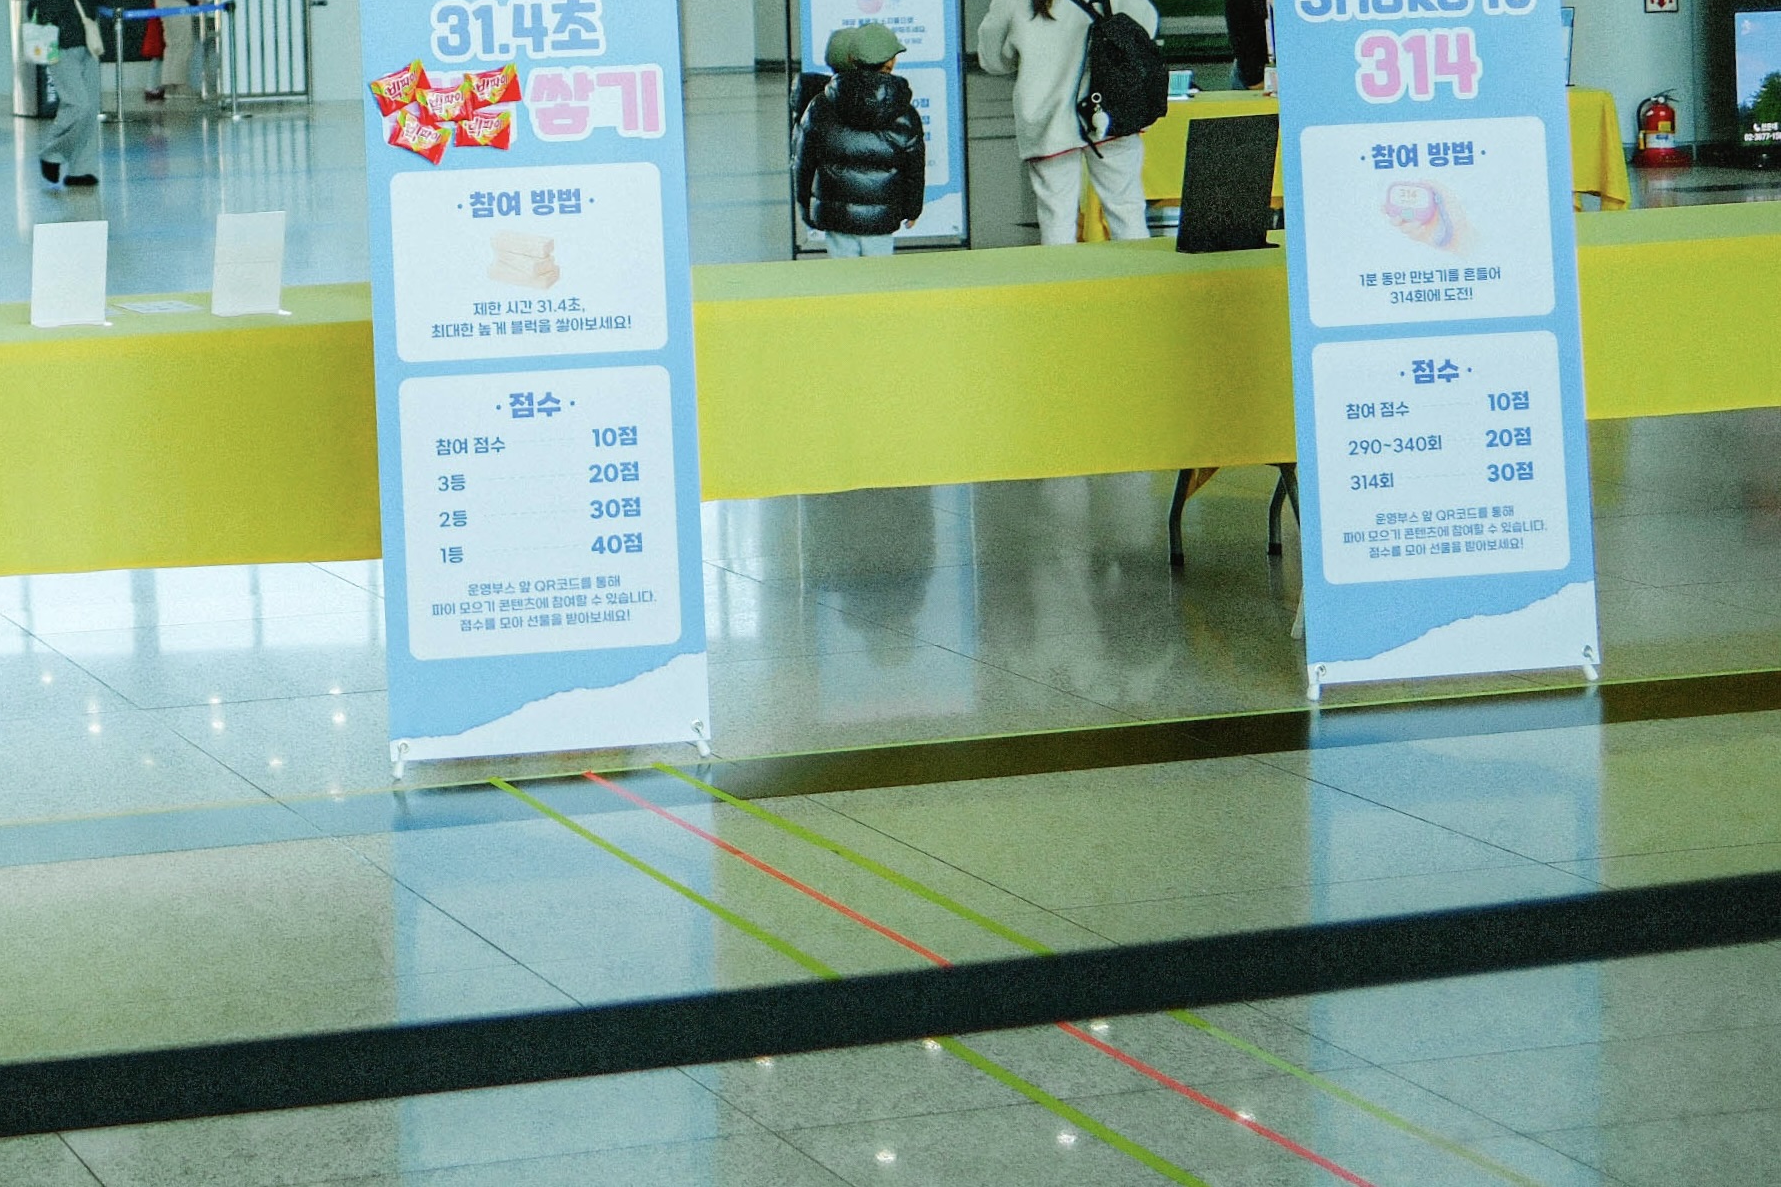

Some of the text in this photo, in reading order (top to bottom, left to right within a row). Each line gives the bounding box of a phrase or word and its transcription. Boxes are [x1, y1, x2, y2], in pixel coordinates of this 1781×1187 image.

[1360, 32, 1478, 98] 314
[531, 69, 661, 136] 쌓기
[1371, 141, 1475, 170] 참여 방법
[469, 188, 582, 219] 참여 방법
[1359, 266, 1501, 288] 1분 동안 만보기를 흔들어
[472, 297, 586, 317] 제한 시간 31.4초,
[1390, 287, 1474, 304] 314회에 도전!
[431, 315, 632, 339] 최대한 높게 블럭을 쌓아보세요!
[1411, 359, 1459, 384] 점수
[508, 391, 562, 419] 점수
[1345, 390, 1530, 420] 참여 점수 10점
[435, 426, 638, 456] 참여 점수 10점
[1348, 426, 1532, 456] 290~340회 20점
[437, 461, 640, 492] 3등 20점
[1350, 461, 1534, 491] 314회 30점
[439, 497, 642, 528] 2등 30점
[440, 532, 644, 564] 1등 40점
